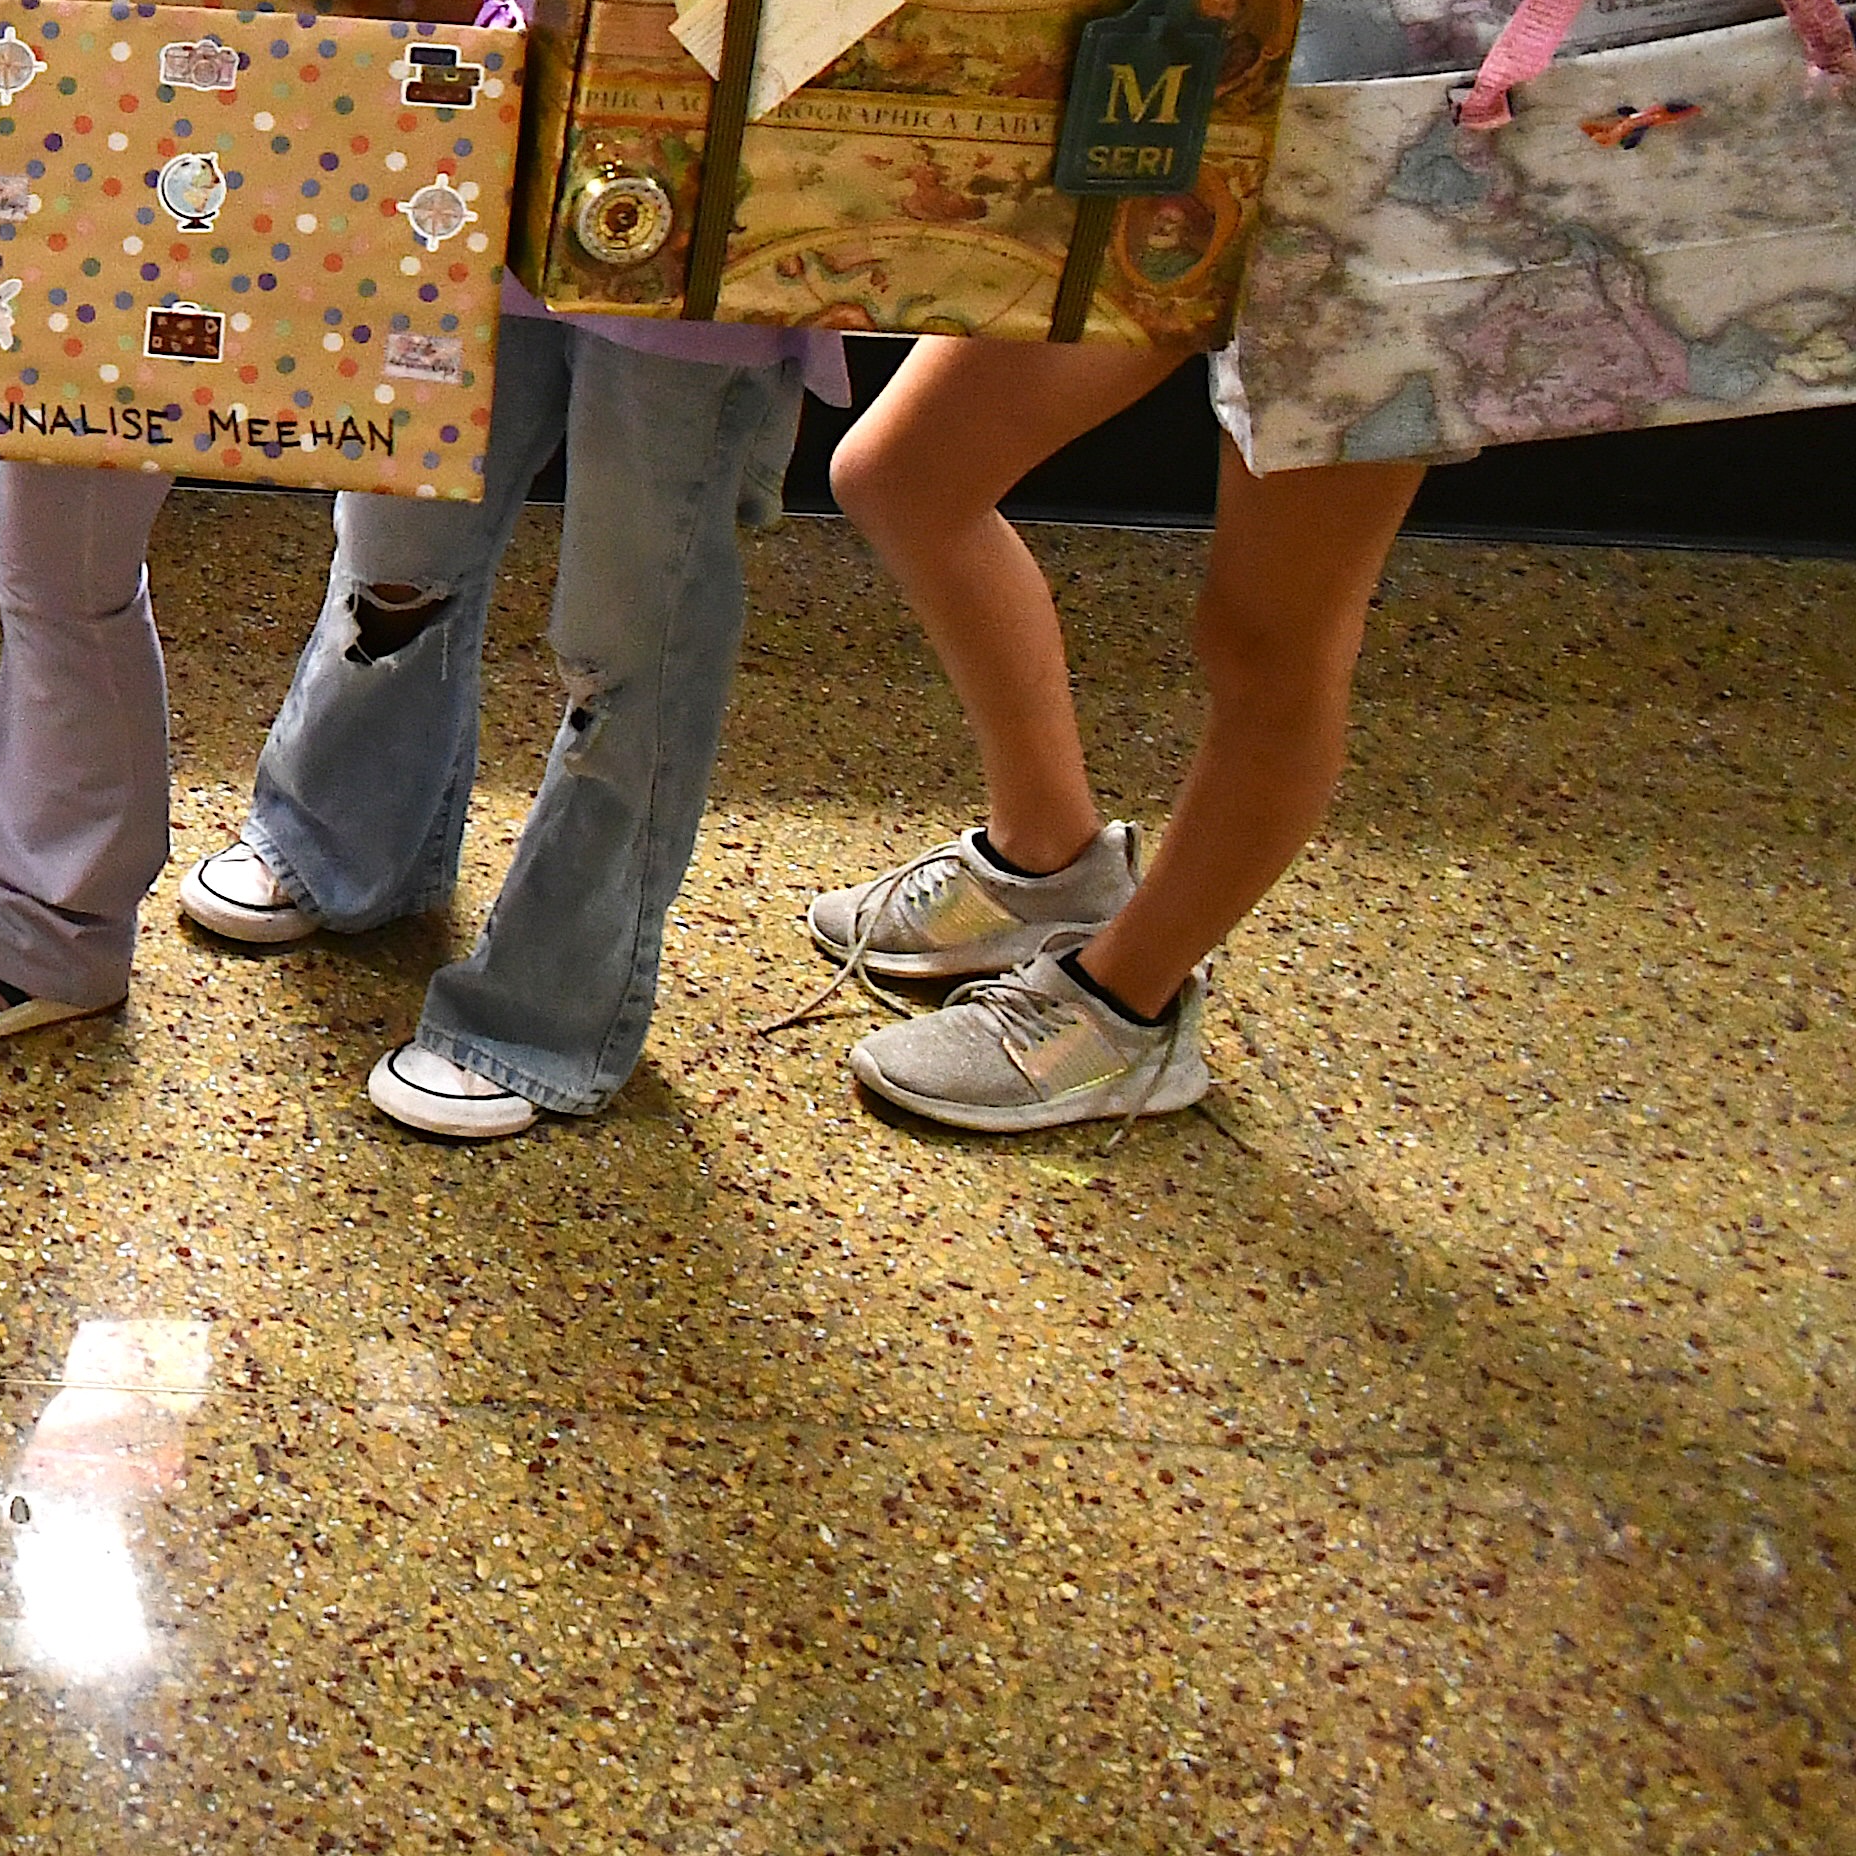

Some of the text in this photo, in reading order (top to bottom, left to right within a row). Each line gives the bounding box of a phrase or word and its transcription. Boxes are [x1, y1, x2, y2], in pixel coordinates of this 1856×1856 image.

[1097, 63, 1193, 124] M
[1085, 145, 1174, 176] SERI
[207, 410, 395, 457] MEEHAN
